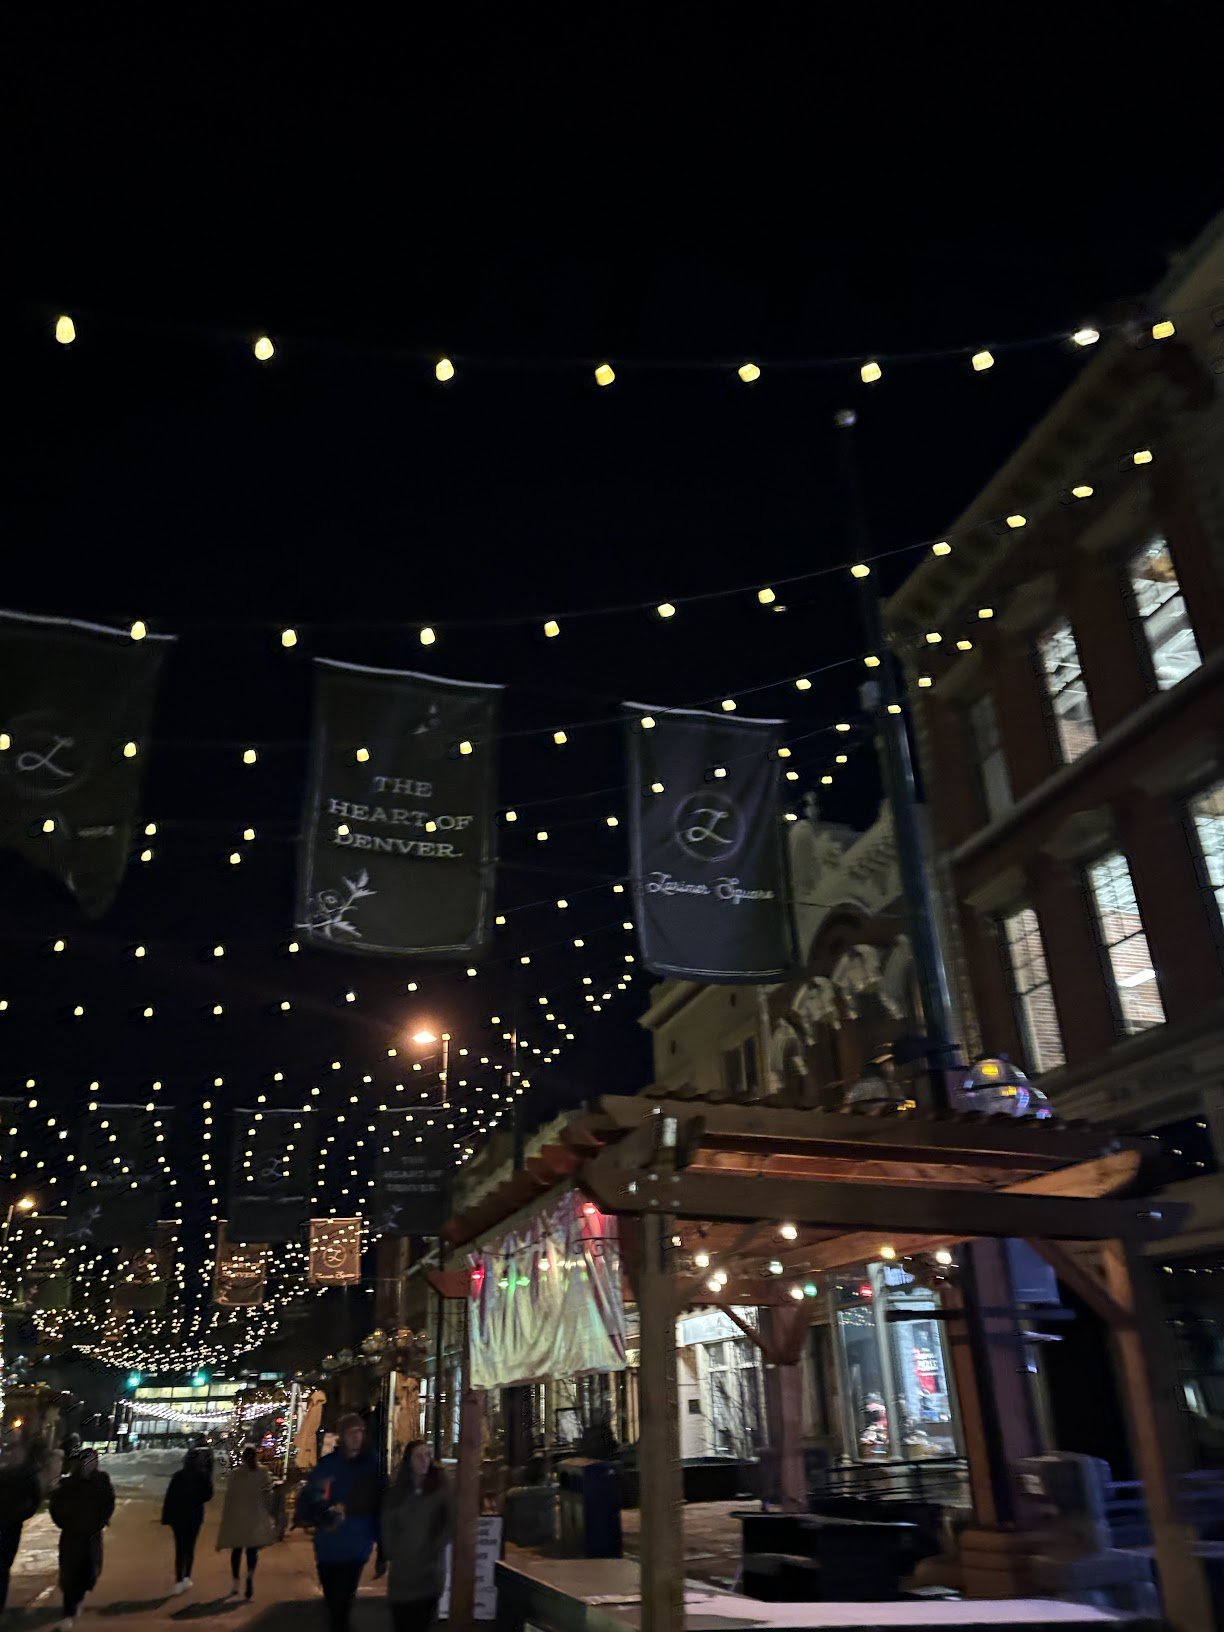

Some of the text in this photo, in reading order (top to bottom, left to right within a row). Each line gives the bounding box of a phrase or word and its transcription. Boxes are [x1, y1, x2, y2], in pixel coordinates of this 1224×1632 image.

[374, 776, 433, 797] THE
[328, 798, 475, 830] HEART OF
[333, 829, 463, 858] DENVER
